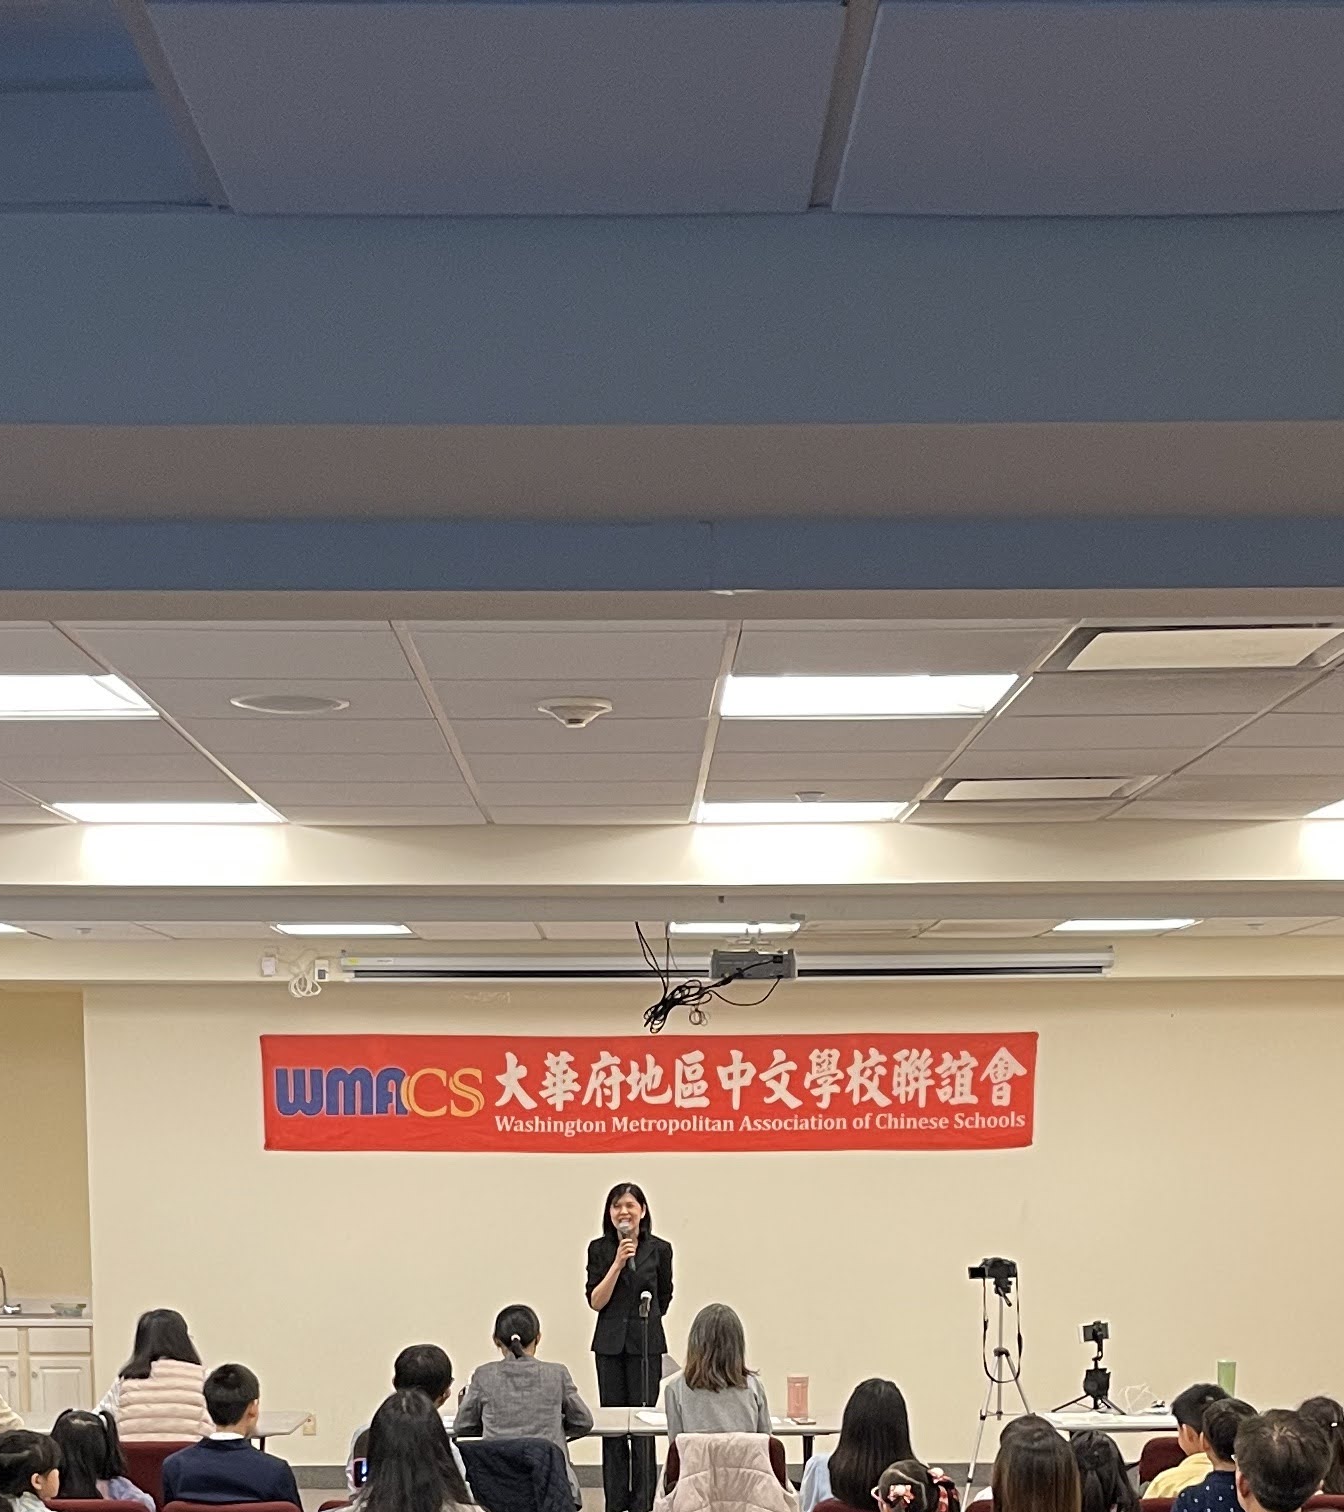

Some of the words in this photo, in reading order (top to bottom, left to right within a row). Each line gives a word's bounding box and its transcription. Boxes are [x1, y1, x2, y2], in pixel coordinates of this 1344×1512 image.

[274, 1066, 485, 1118] WMACS
[494, 1047, 1028, 1112] 大華府地區中文學校聯誼會
[495, 1115, 606, 1136] Washington
[611, 1115, 734, 1135] Metropolitan
[739, 1113, 848, 1131] Association
[852, 1112, 874, 1130] of
[876, 1112, 949, 1130] Chinese
[953, 1110, 1026, 1129] Schools
